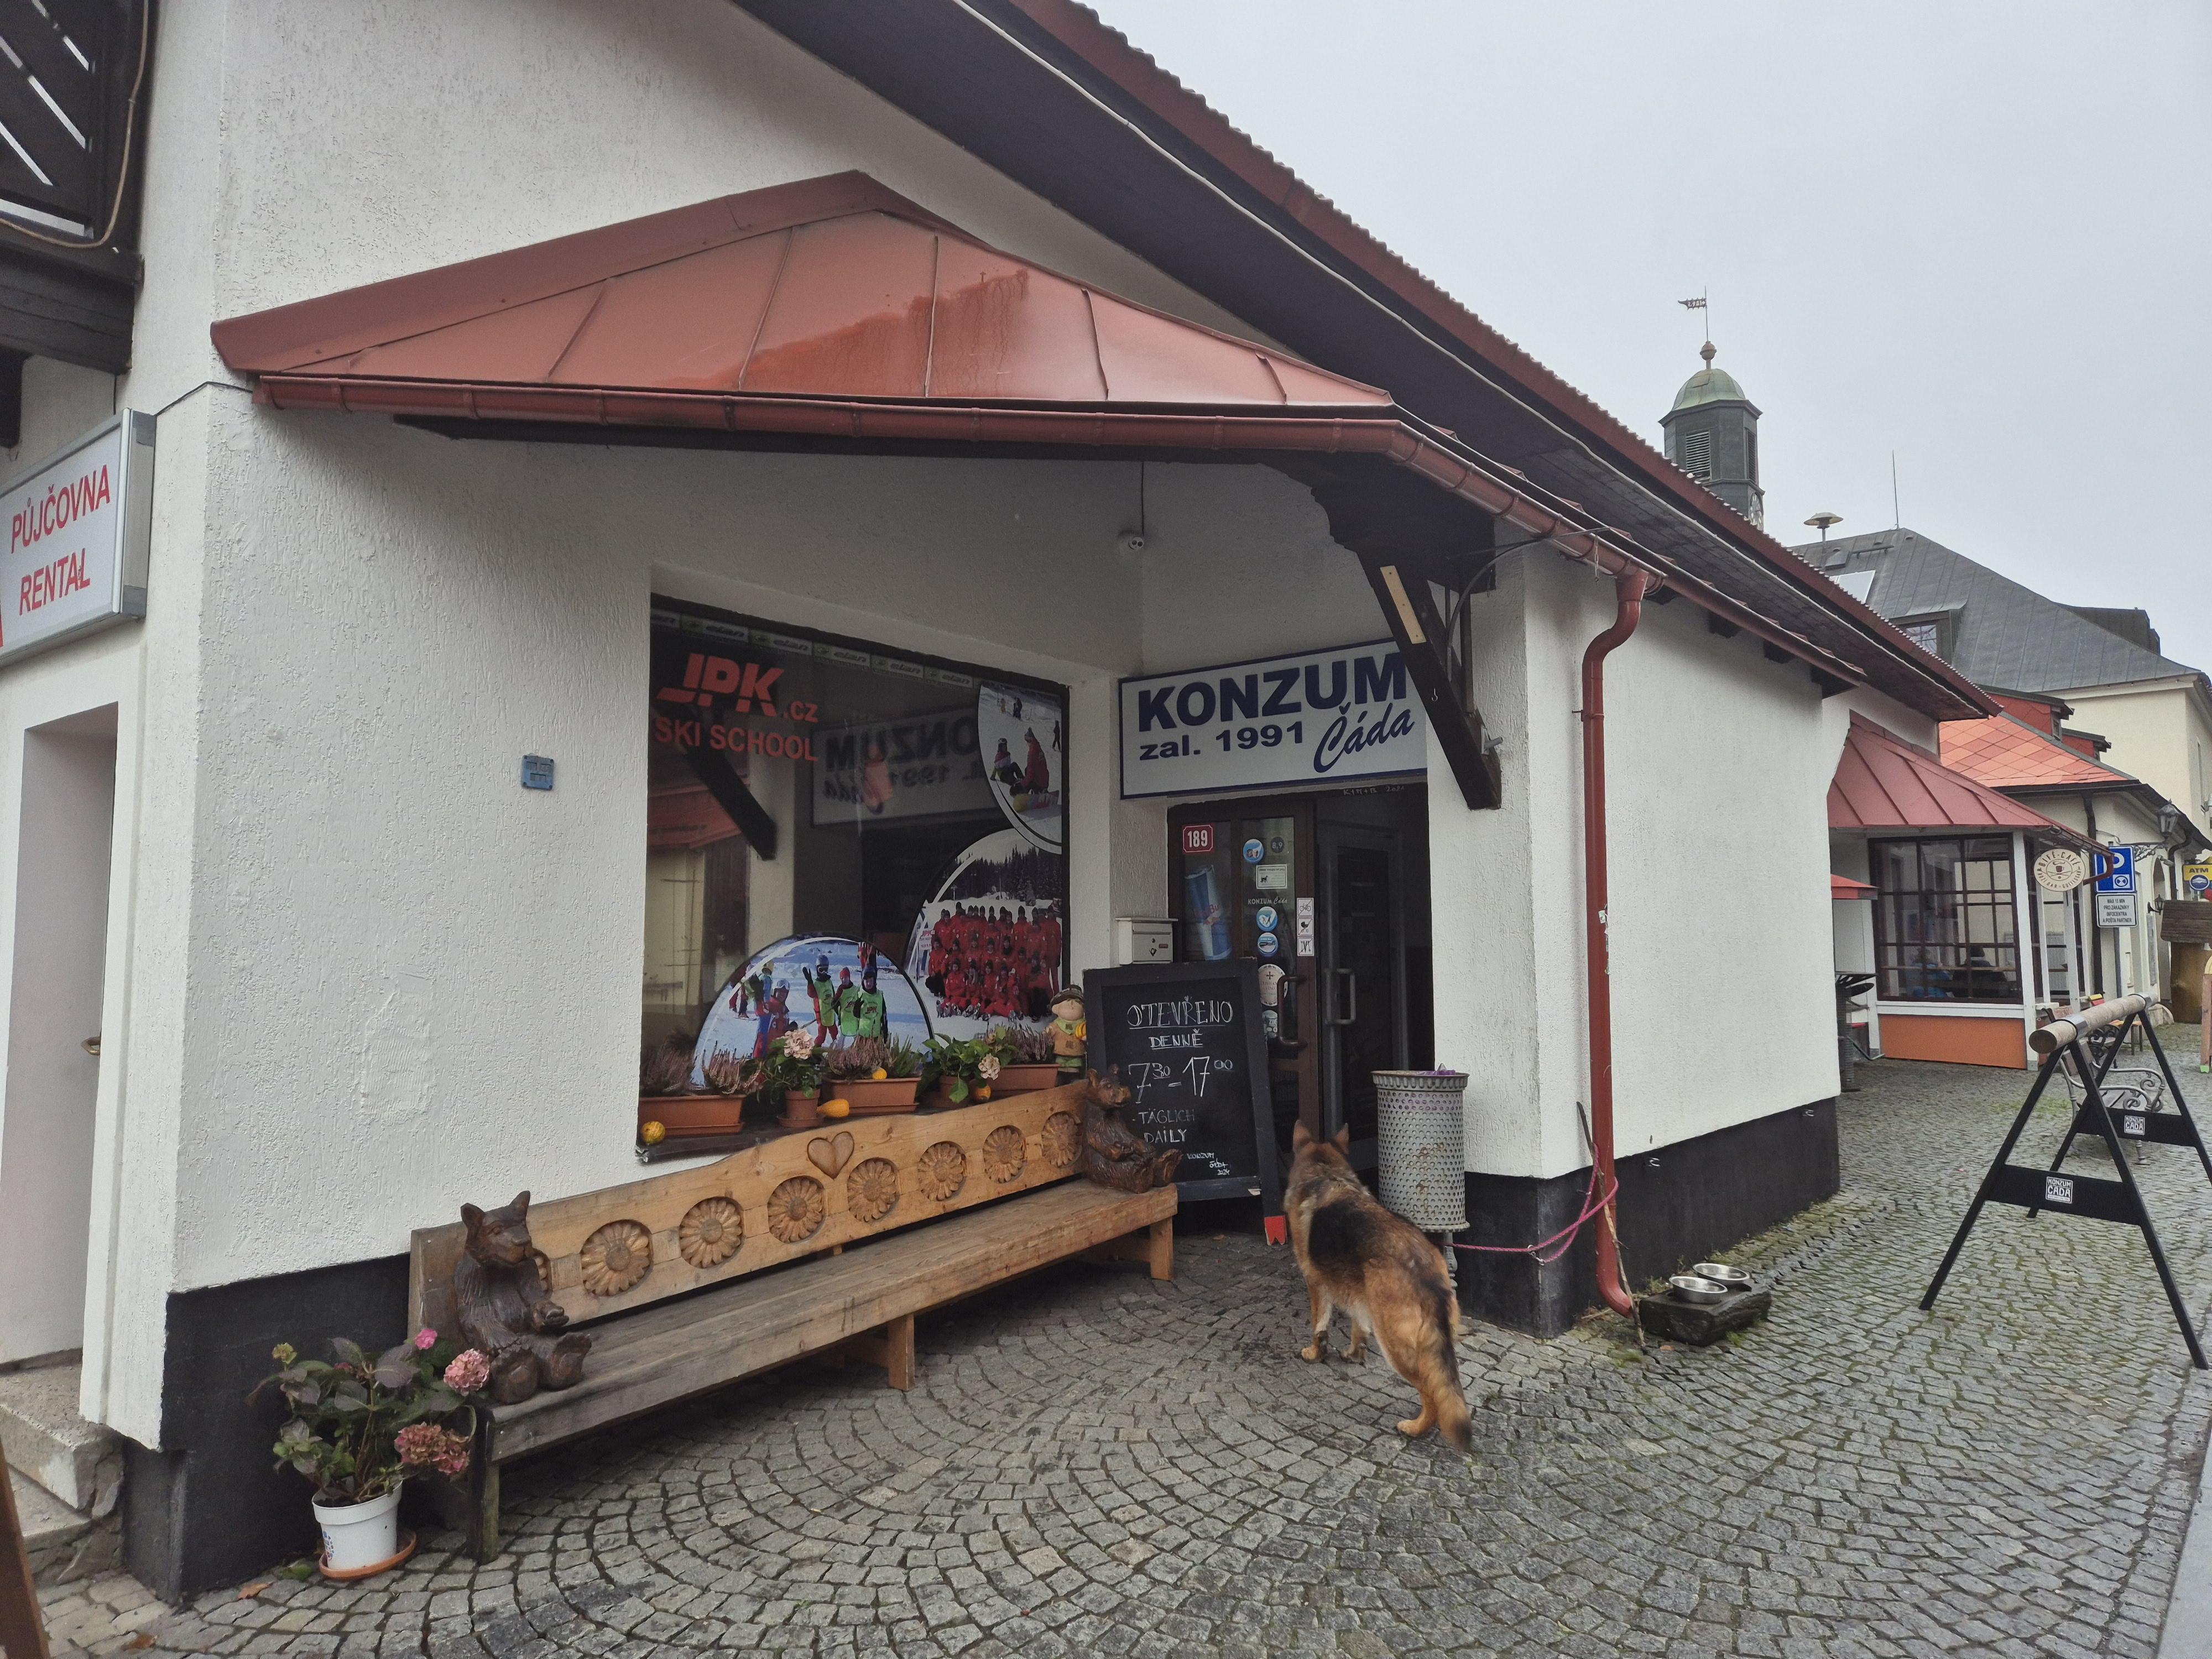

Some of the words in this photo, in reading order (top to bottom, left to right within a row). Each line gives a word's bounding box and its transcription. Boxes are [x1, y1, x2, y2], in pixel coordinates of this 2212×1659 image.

[11, 464, 111, 554] PŮJČOVNA
[19, 547, 90, 615] RENTAL
[1138, 651, 1407, 732] KONZUM
[655, 717, 701, 747] SKI
[709, 724, 818, 761] SCHOOL
[1139, 734, 1201, 761] zal.
[1215, 721, 1304, 752] 1991
[1313, 701, 1416, 774] Čáda
[1187, 830, 1208, 848] 189
[1127, 995, 1234, 1027] OTEVŘENO
[1149, 1028, 1203, 1048] DENNĚ
